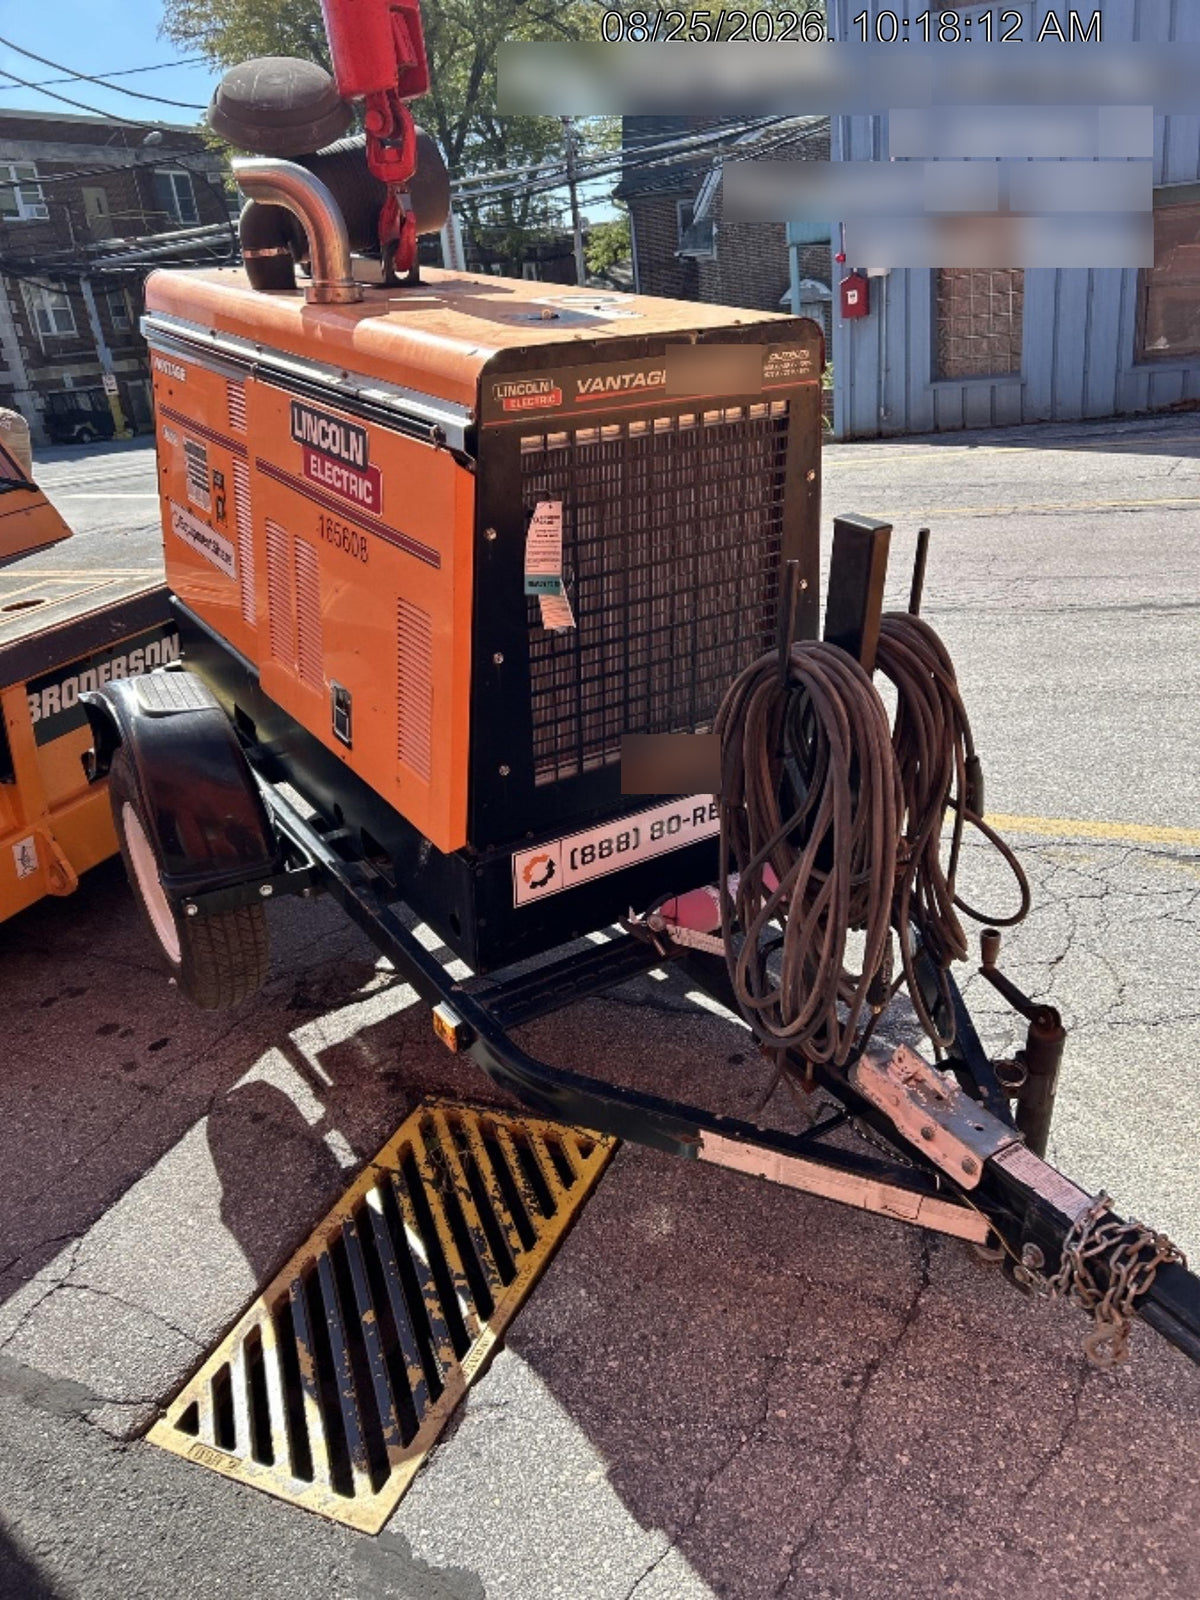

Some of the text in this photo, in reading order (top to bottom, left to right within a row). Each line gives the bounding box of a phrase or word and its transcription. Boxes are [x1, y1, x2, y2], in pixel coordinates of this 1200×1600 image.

[496, 381, 549, 398] LINCOLN
[510, 394, 556, 408] ELECTRIC
[576, 369, 666, 394] VANTAG
[294, 407, 364, 466] LINCOLN
[310, 454, 372, 504] ELECTRIC
[319, 515, 368, 563] 165608
[28, 633, 180, 724] BRODERSON
[570, 804, 720, 870] (888) 80-RE
